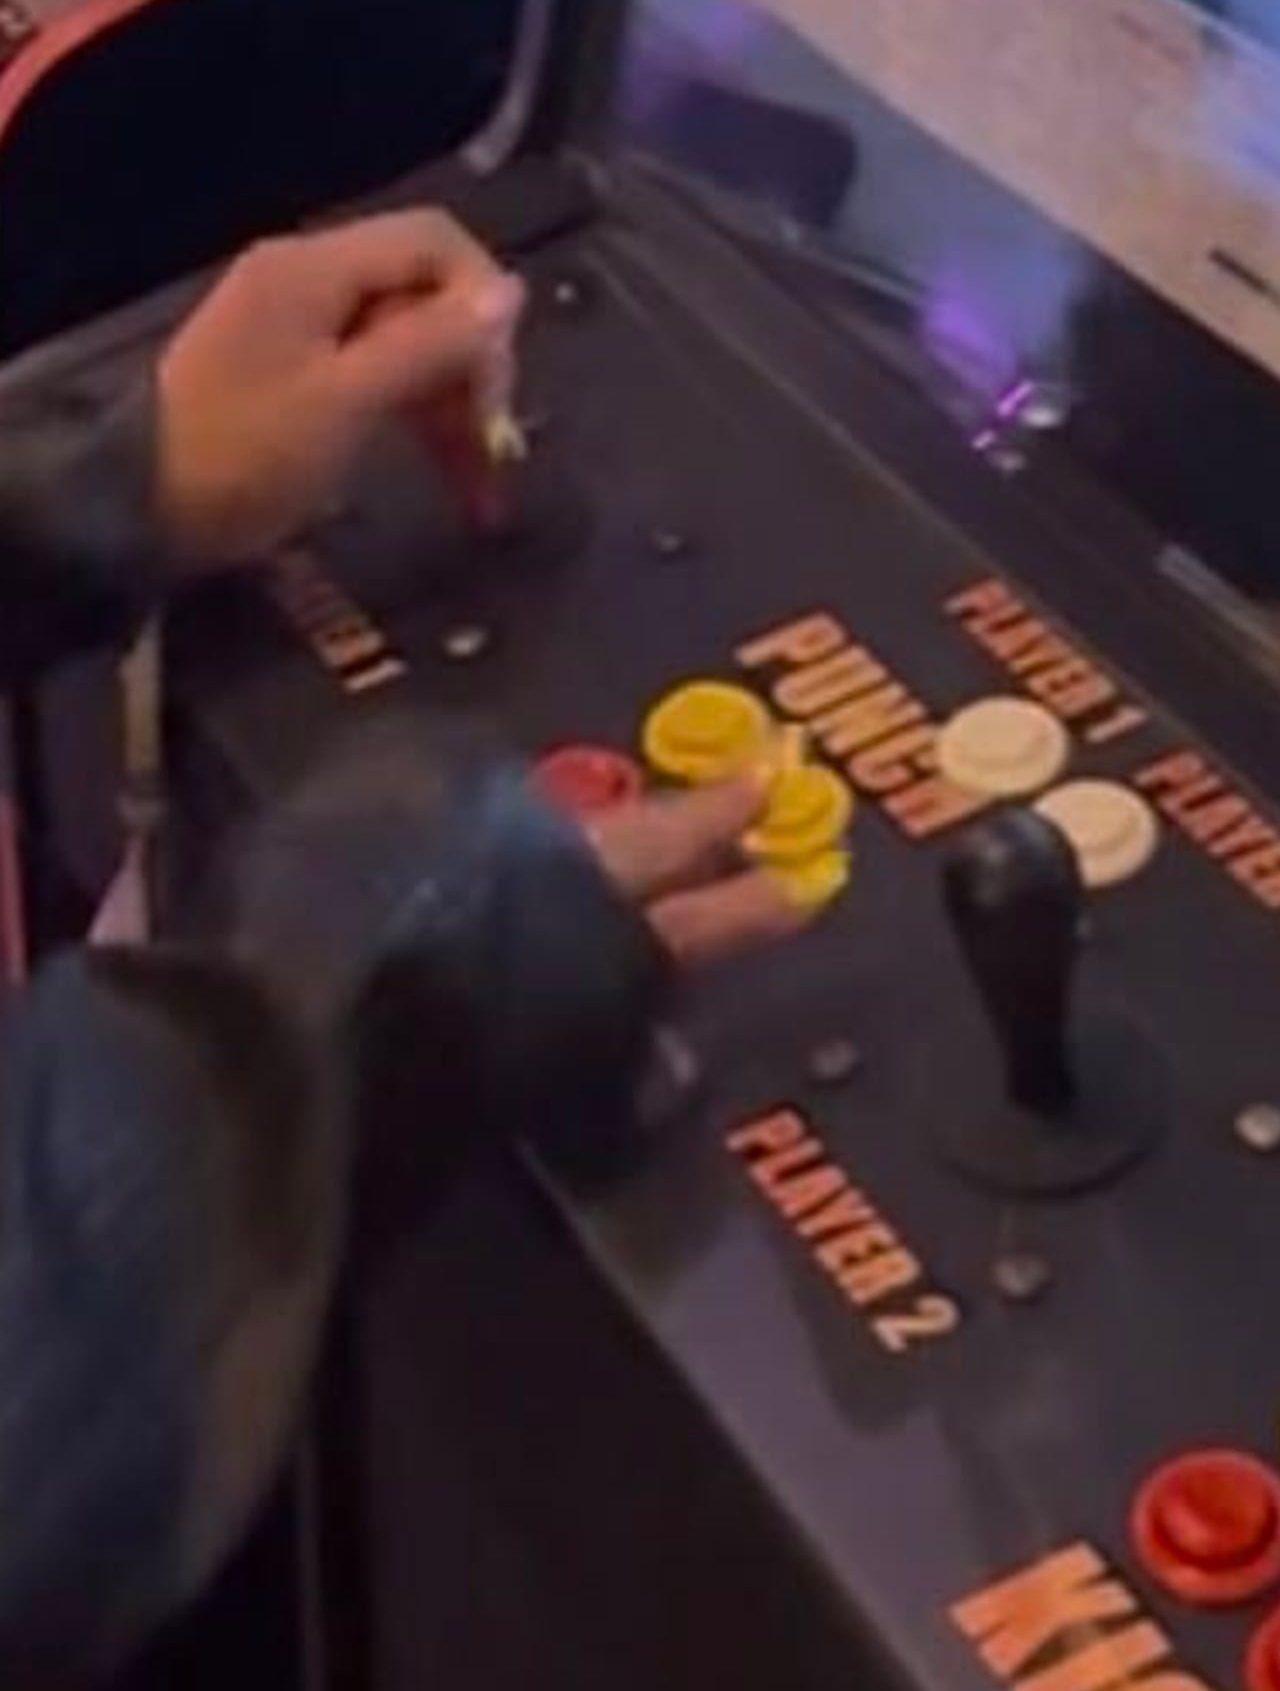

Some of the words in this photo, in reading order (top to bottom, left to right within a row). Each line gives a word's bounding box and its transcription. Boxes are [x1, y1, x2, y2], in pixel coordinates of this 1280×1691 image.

[943, 576, 1116, 718] PLAYER
[1085, 705, 1148, 744] 1
[725, 1107, 921, 1307] PLAYER
[871, 1294, 959, 1352] 2
